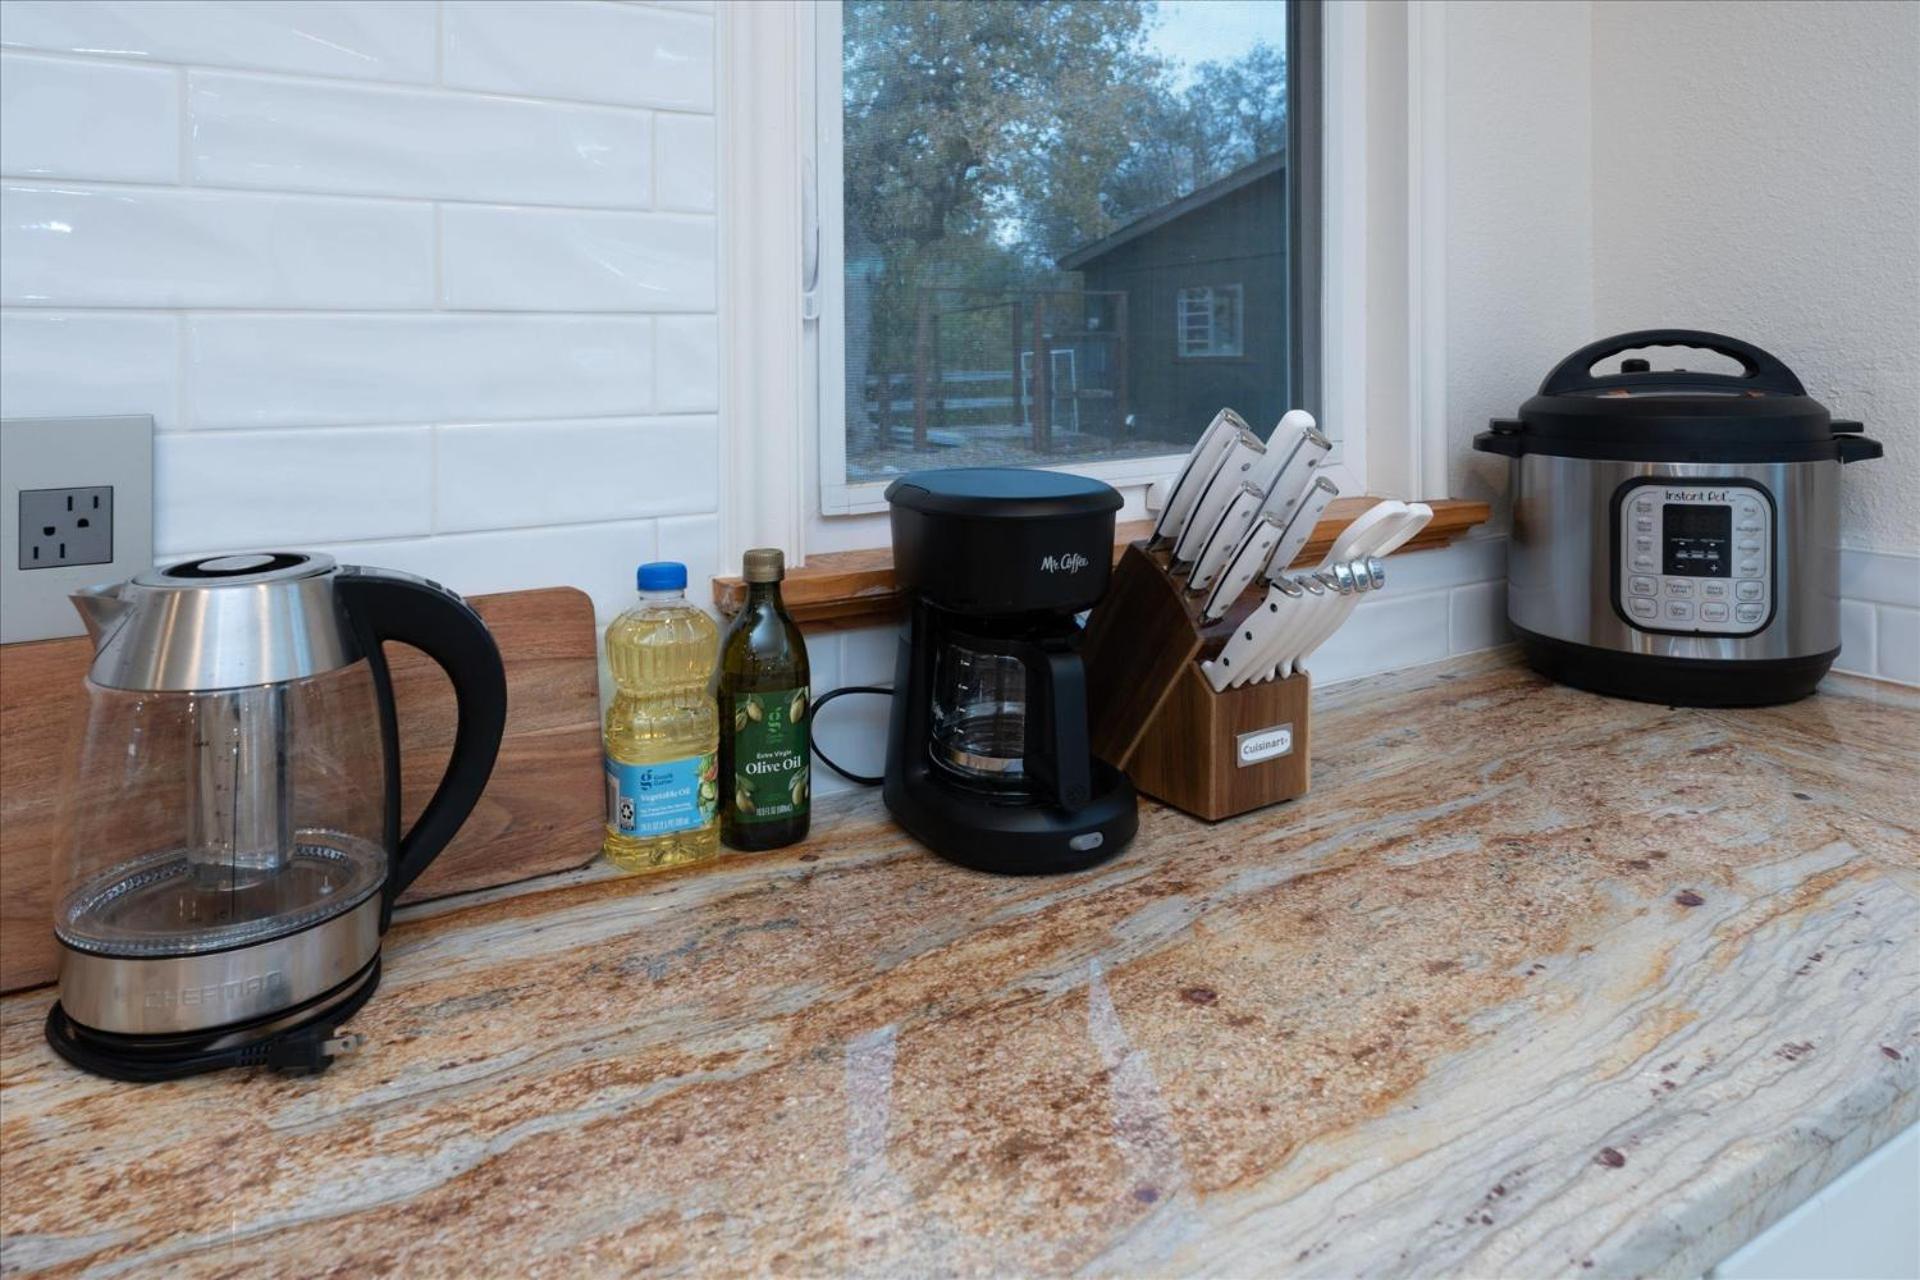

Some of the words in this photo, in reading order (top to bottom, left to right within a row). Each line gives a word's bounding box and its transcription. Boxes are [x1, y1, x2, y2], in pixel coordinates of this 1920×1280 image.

[1665, 489, 1704, 502] Instant
[1707, 490, 1727, 503] Pot
[1060, 553, 1089, 574] Coffee
[1243, 737, 1285, 755] Cuisinart
[745, 761, 781, 775] Olive
[782, 755, 801, 770] Oil
[756, 752, 773, 760] Extra
[640, 790, 678, 802] Vegetable
[678, 787, 691, 796] Oil
[144, 970, 282, 1008] CHEFMAN
